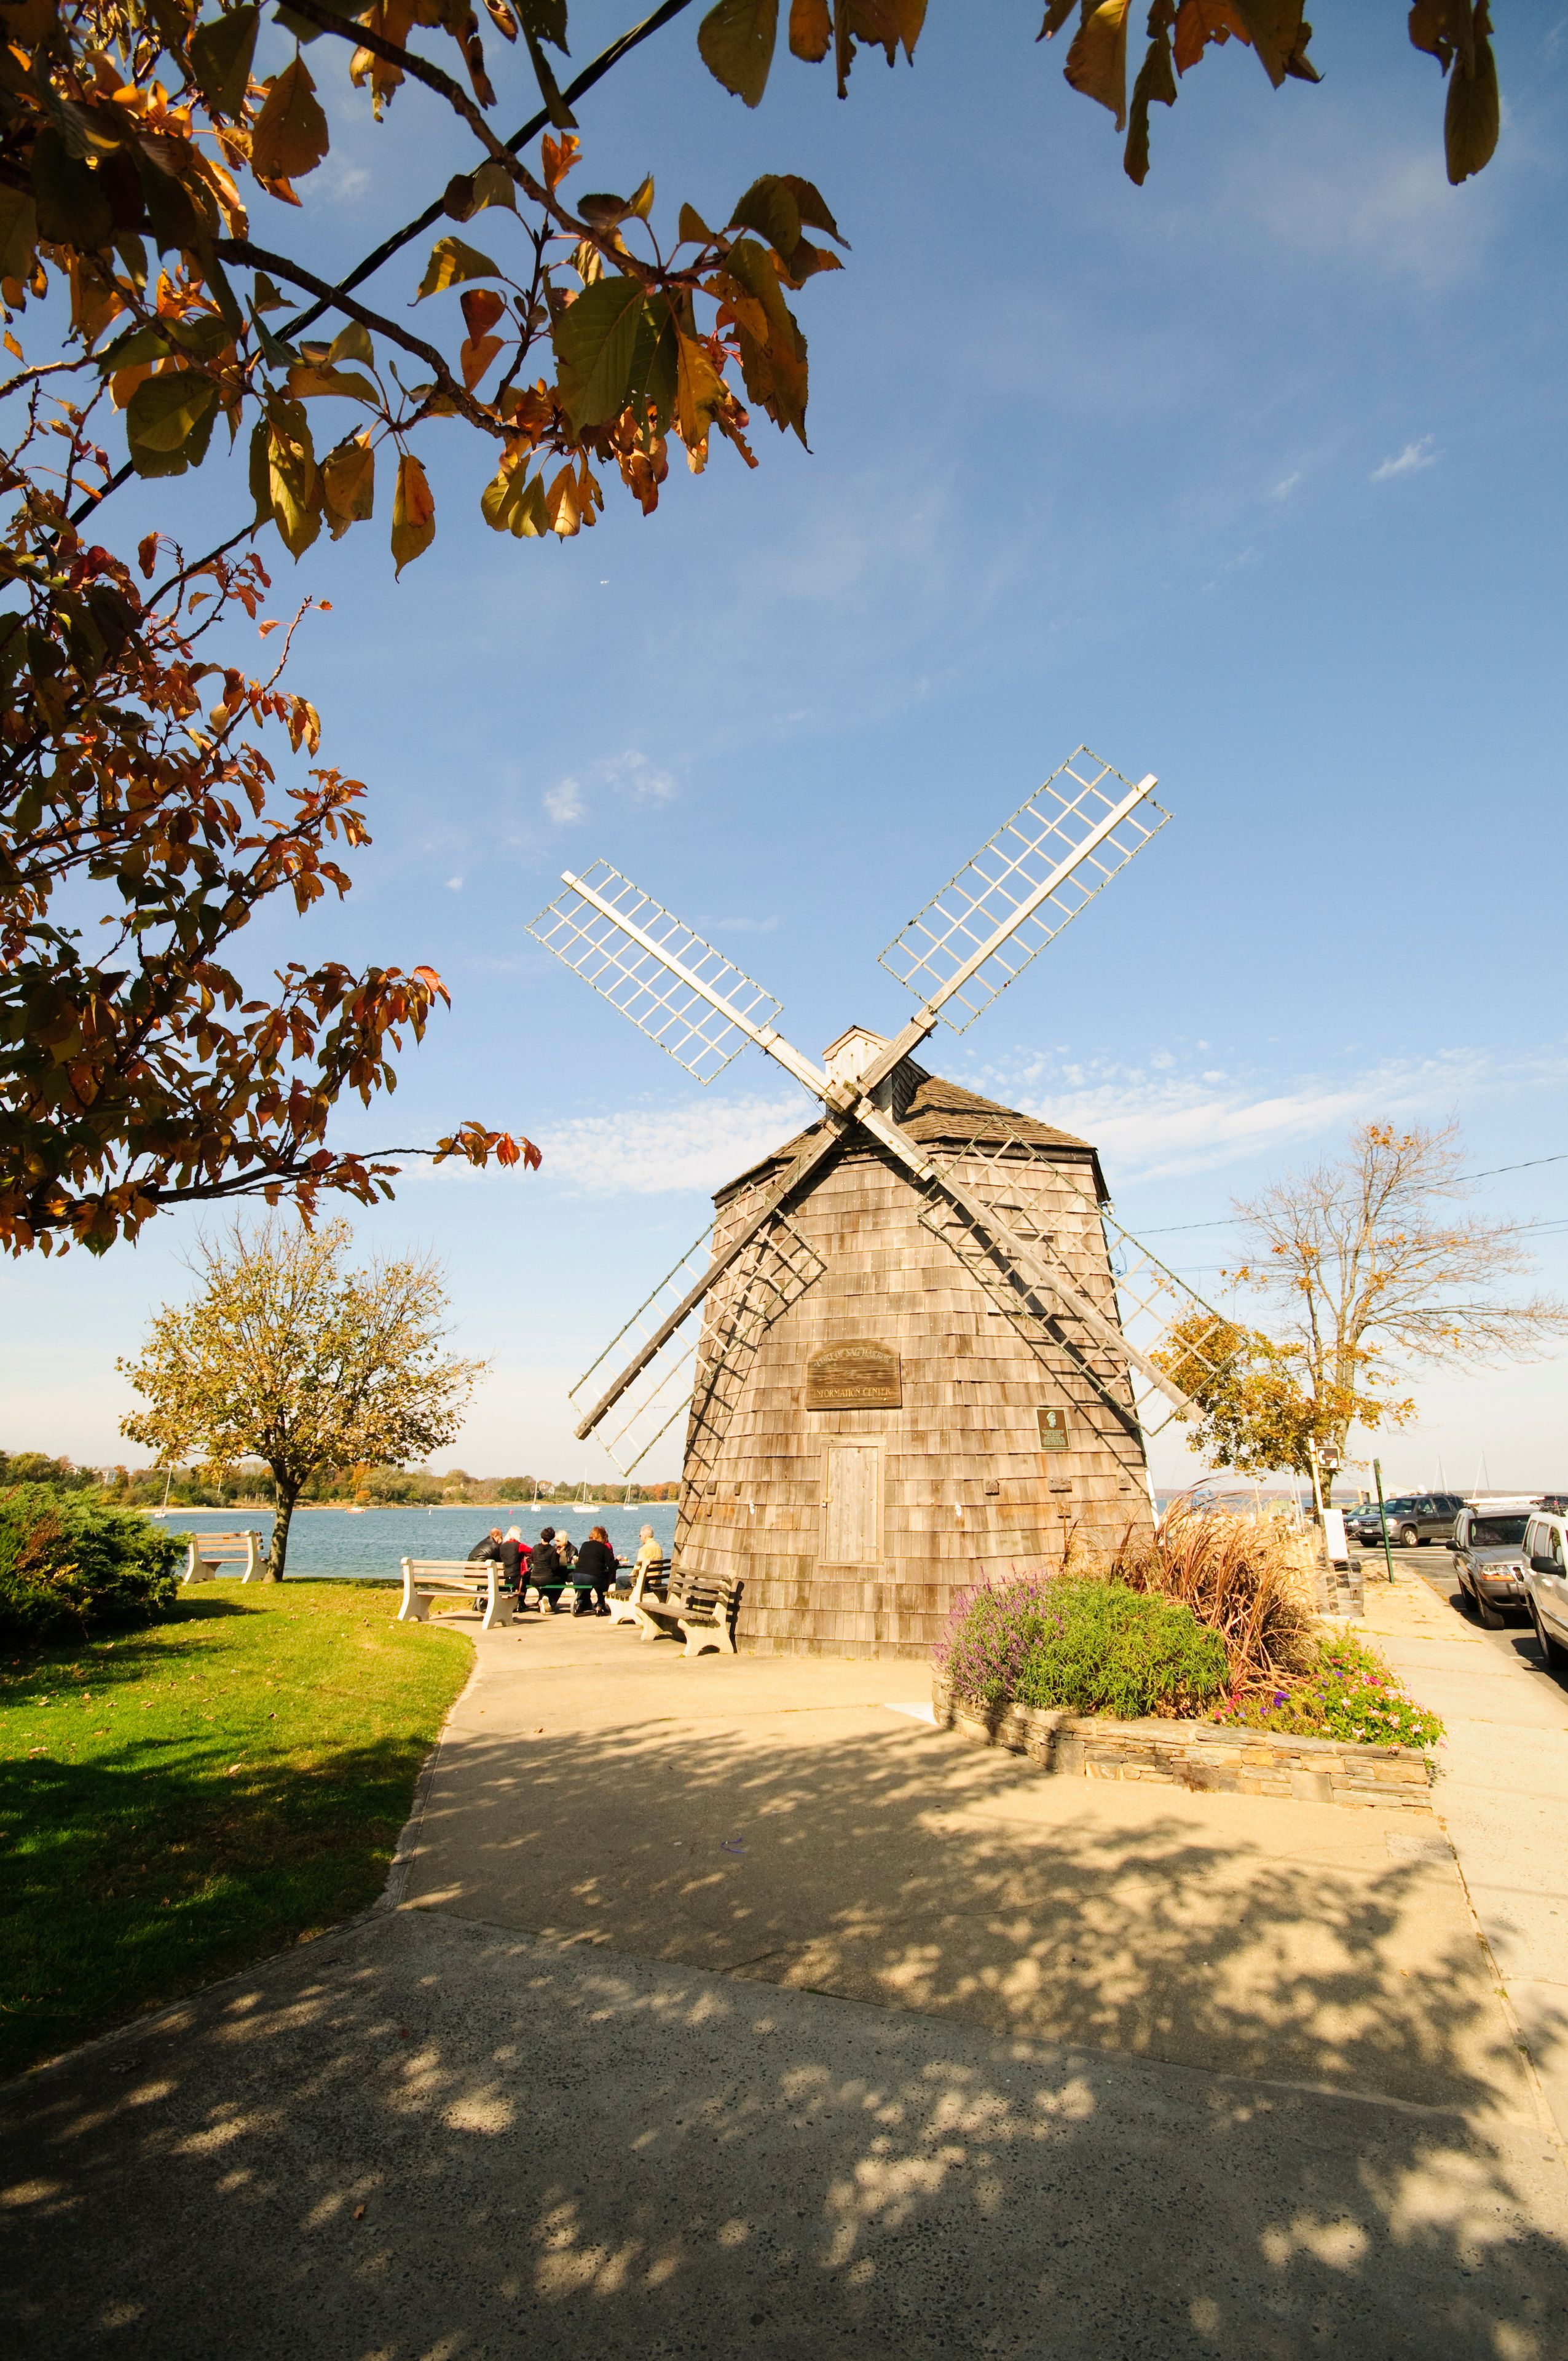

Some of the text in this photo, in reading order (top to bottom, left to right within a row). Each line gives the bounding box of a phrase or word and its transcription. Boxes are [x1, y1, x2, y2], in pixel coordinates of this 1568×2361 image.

[846, 1348, 861, 1358] SAG
[814, 1386, 891, 1398] INFORMATION CENTER
